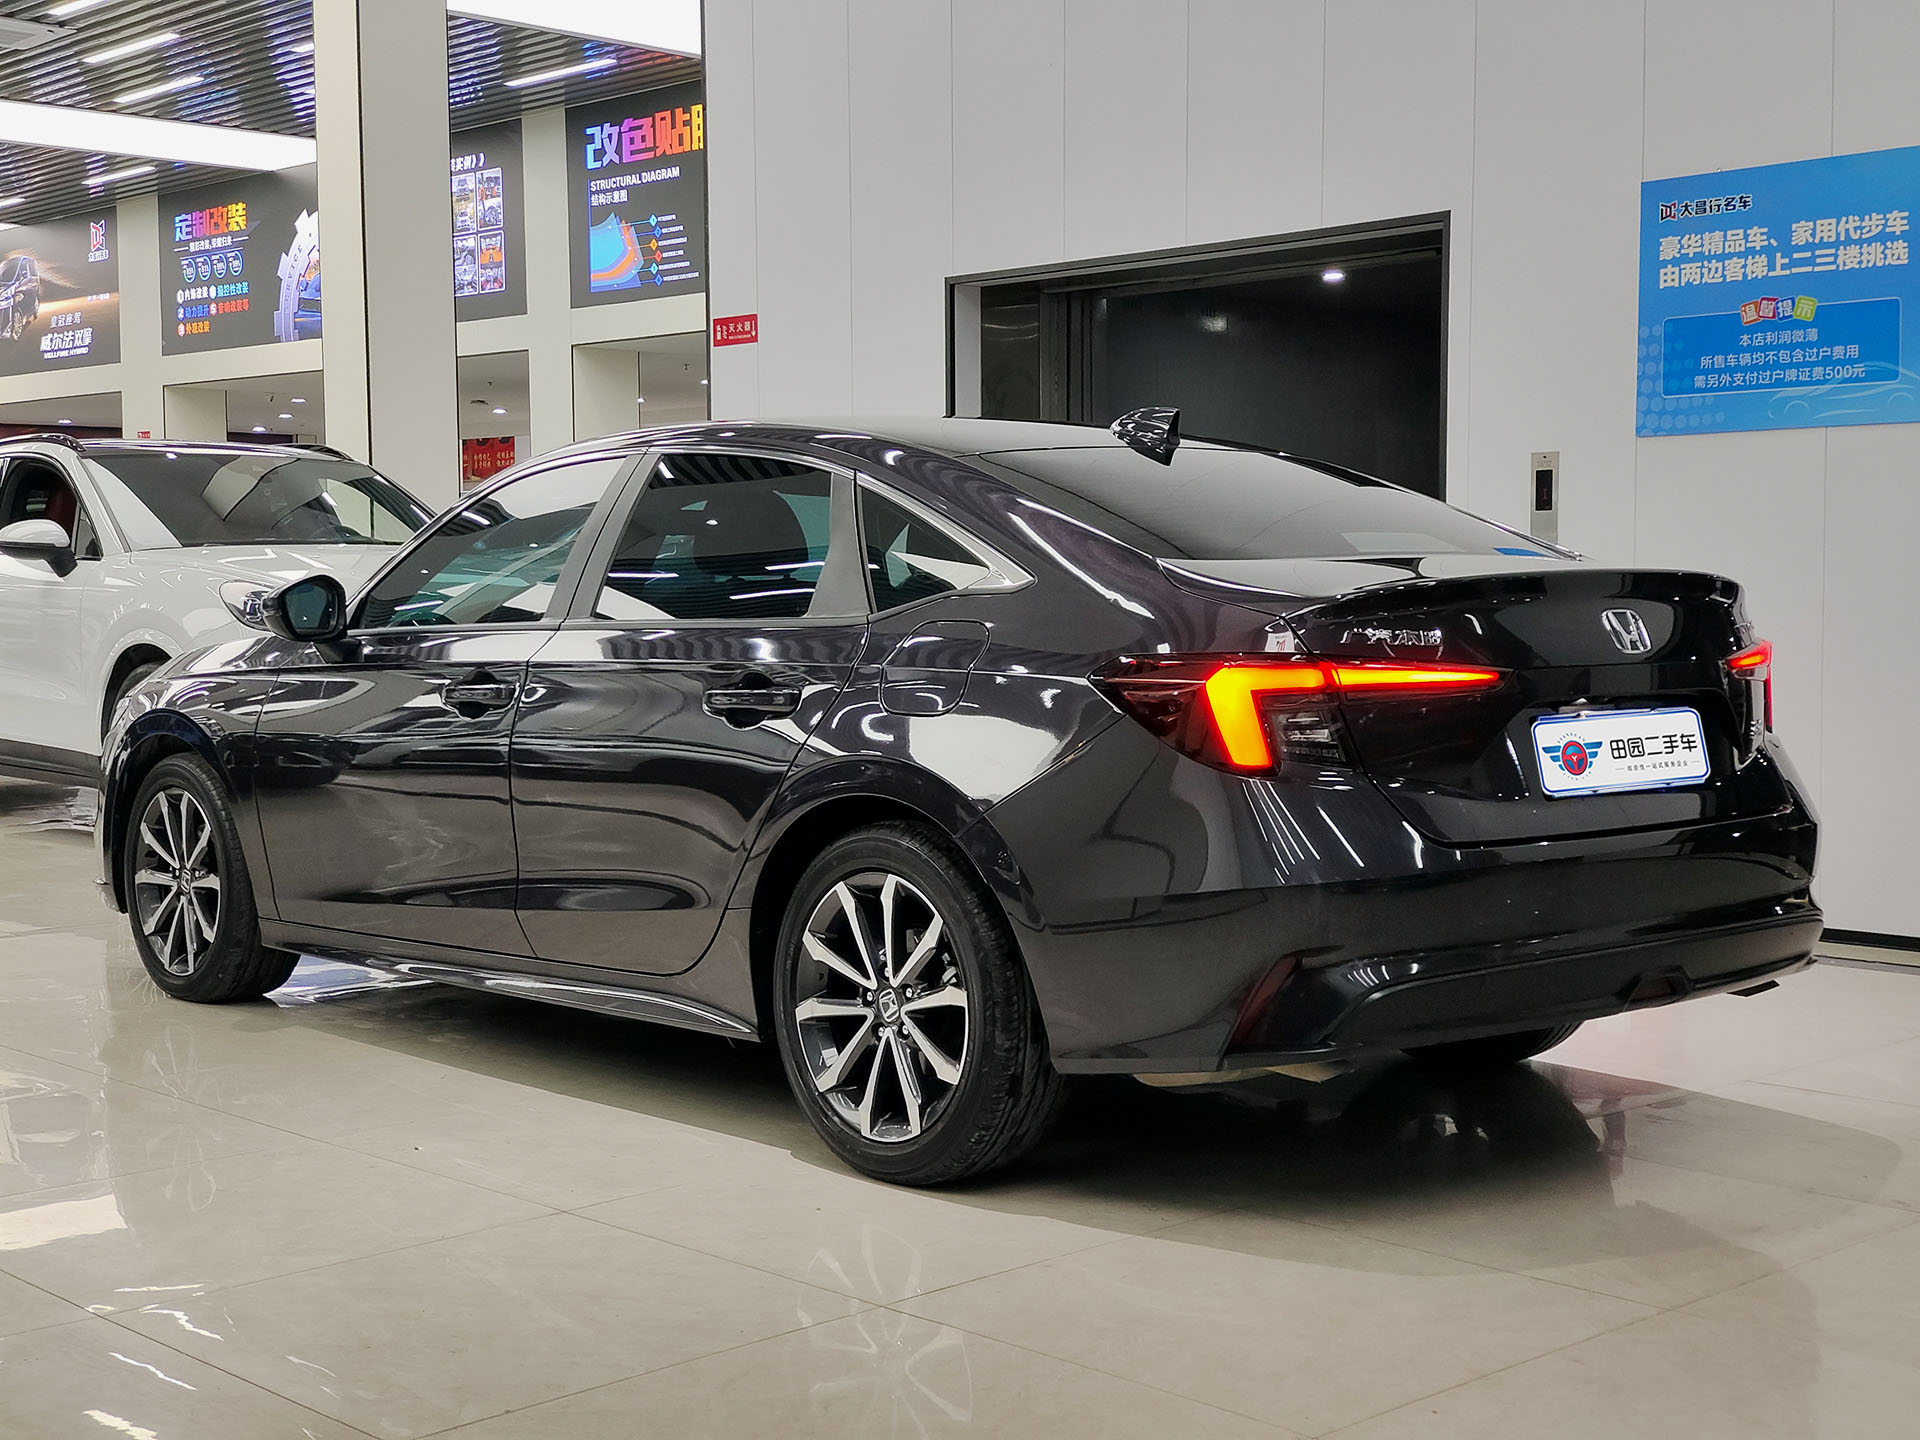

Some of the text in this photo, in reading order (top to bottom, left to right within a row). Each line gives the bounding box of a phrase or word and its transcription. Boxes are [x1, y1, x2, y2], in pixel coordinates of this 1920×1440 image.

[590, 166, 680, 191] STRUCTURAL DIAGRAM
[591, 189, 628, 207] 结构示意图
[1679, 194, 1752, 217] 大昌行名车
[175, 202, 247, 241] 定制改装
[1659, 210, 1910, 260] 豪华精品车、家用代步车
[1659, 240, 1909, 288] 由两边客梯上二三楼挑选
[50, 311, 81, 328] 皇冠座驾
[1741, 298, 1815, 322] 温馨提示
[1739, 328, 1819, 347] 本店利润微薄
[1700, 345, 1860, 369] 所售车辆均不包含过户费用
[1694, 364, 1866, 389] 需另外支付过户牌证费500元
[1609, 733, 1698, 760] 田园二手车
